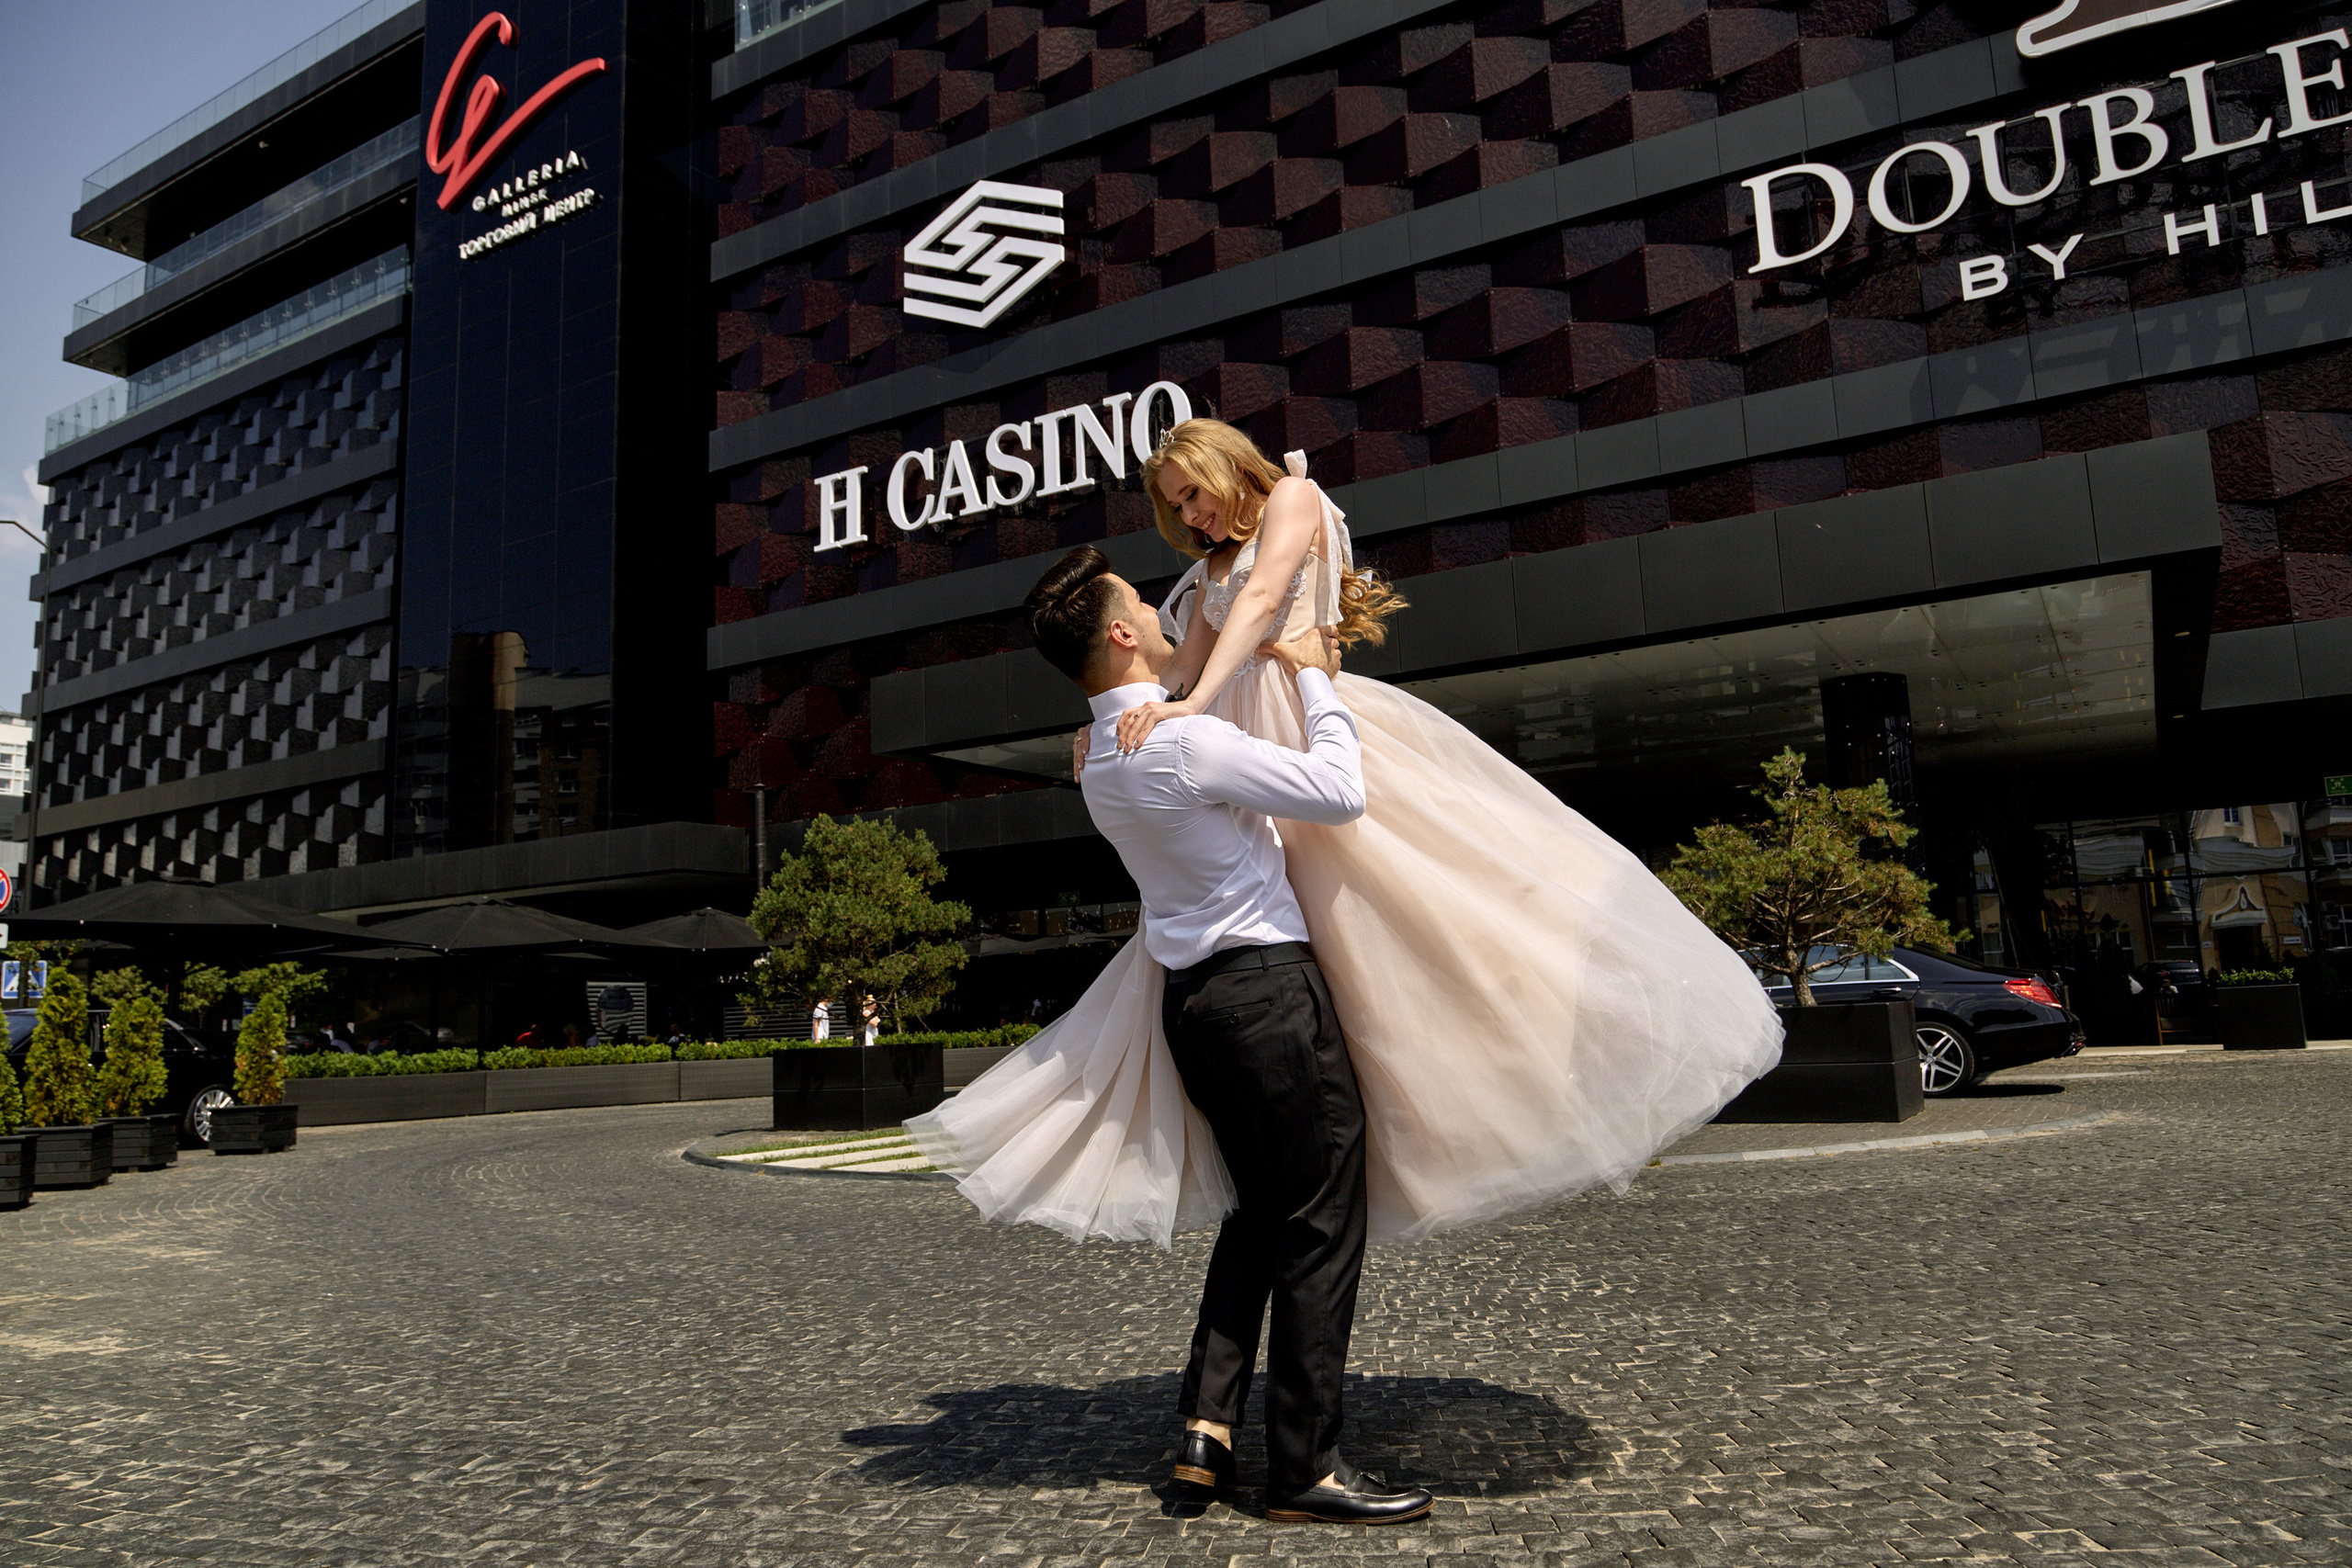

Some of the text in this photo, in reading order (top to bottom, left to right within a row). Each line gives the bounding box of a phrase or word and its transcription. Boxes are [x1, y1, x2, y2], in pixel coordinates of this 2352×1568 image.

[472, 151, 580, 211] GALLERIA
[1741, 28, 2352, 274] DOUBLE
[458, 187, 595, 260] ТОРГОВЫЙ ЦЕНТР
[502, 187, 549, 217] MINSK
[1959, 180, 2352, 301] BY HIL
[814, 380, 1193, 553] H CASINO
